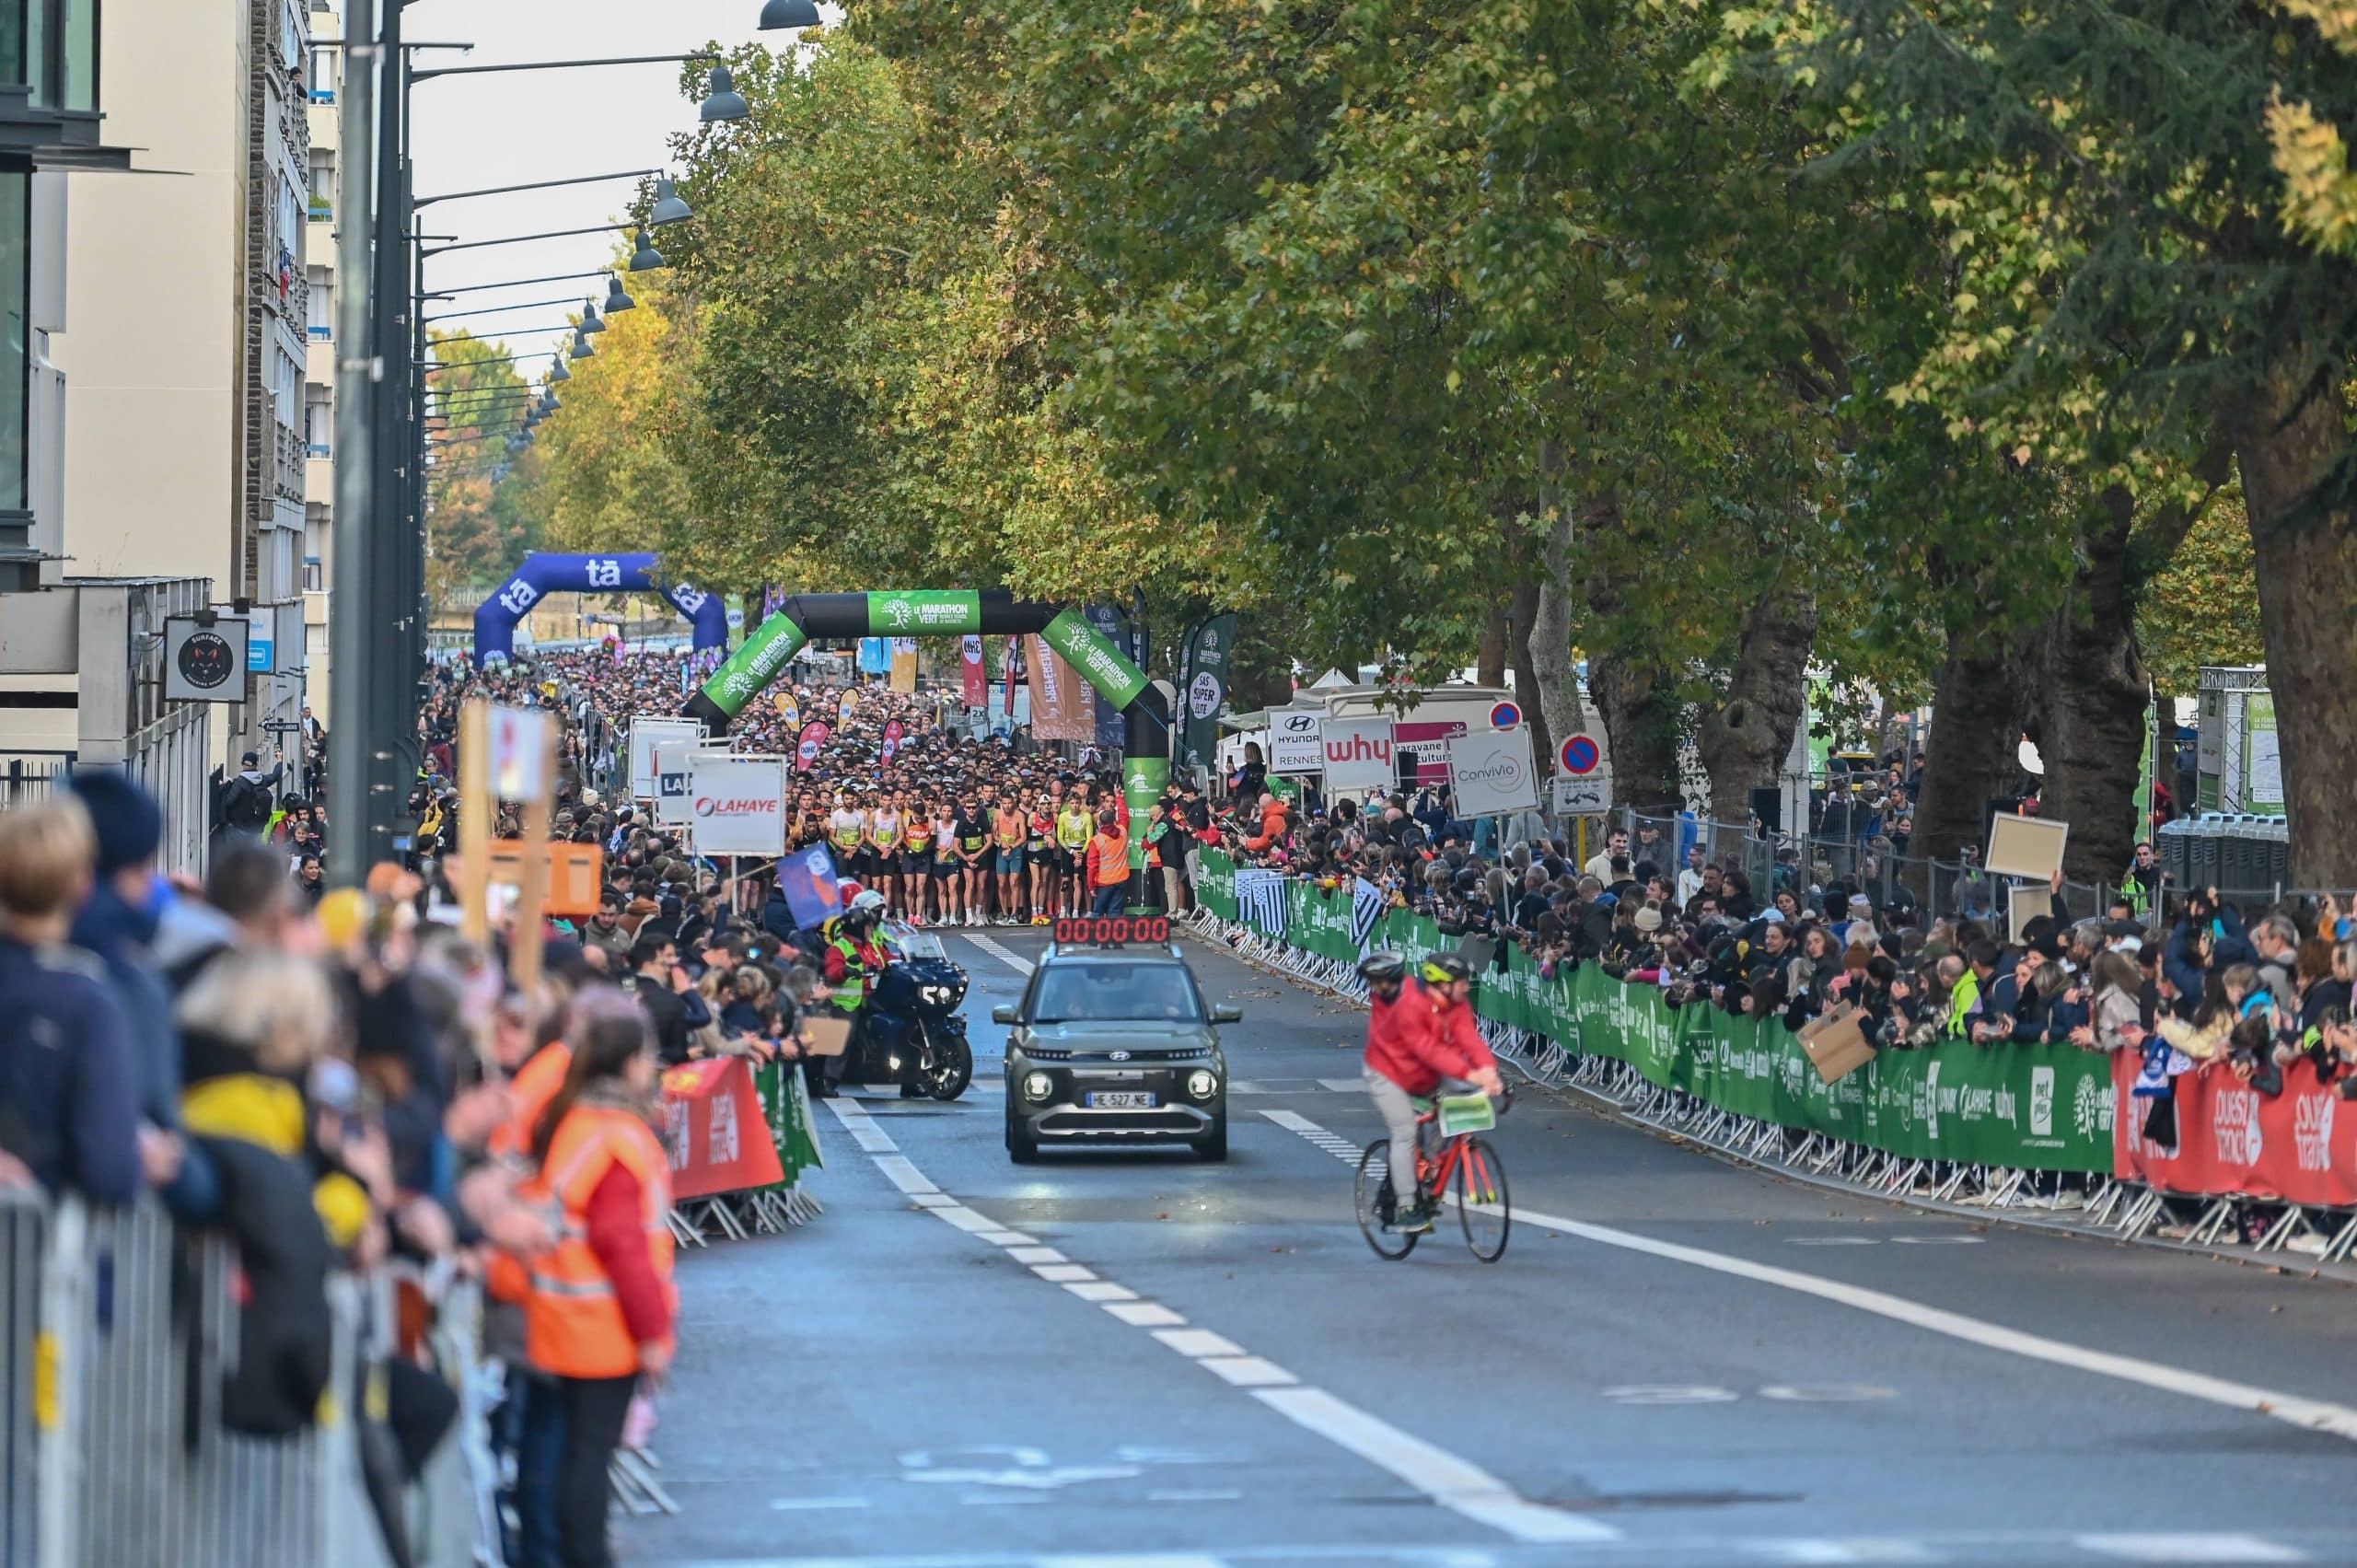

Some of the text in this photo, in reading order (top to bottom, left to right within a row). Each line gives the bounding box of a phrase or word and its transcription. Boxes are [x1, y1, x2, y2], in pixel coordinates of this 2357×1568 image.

[922, 604, 969, 614] MARATHON
[919, 614, 938, 624] VERT
[191, 633, 223, 645] SURFACE
[749, 631, 790, 670] MARATHON
[755, 659, 774, 679] VERT
[1085, 653, 1104, 673] VERT
[1093, 647, 1132, 688] MARATHON
[1200, 675, 1210, 687] SAS
[1193, 688, 1215, 702] SUPER
[1195, 703, 1208, 715] ELITE
[1278, 735, 1319, 745] HYUNDA
[1326, 733, 1391, 767] why
[1280, 755, 1323, 765] RENNES
[715, 799, 778, 812] LAHAYE
[1055, 917, 1168, 943] 00:00:00
